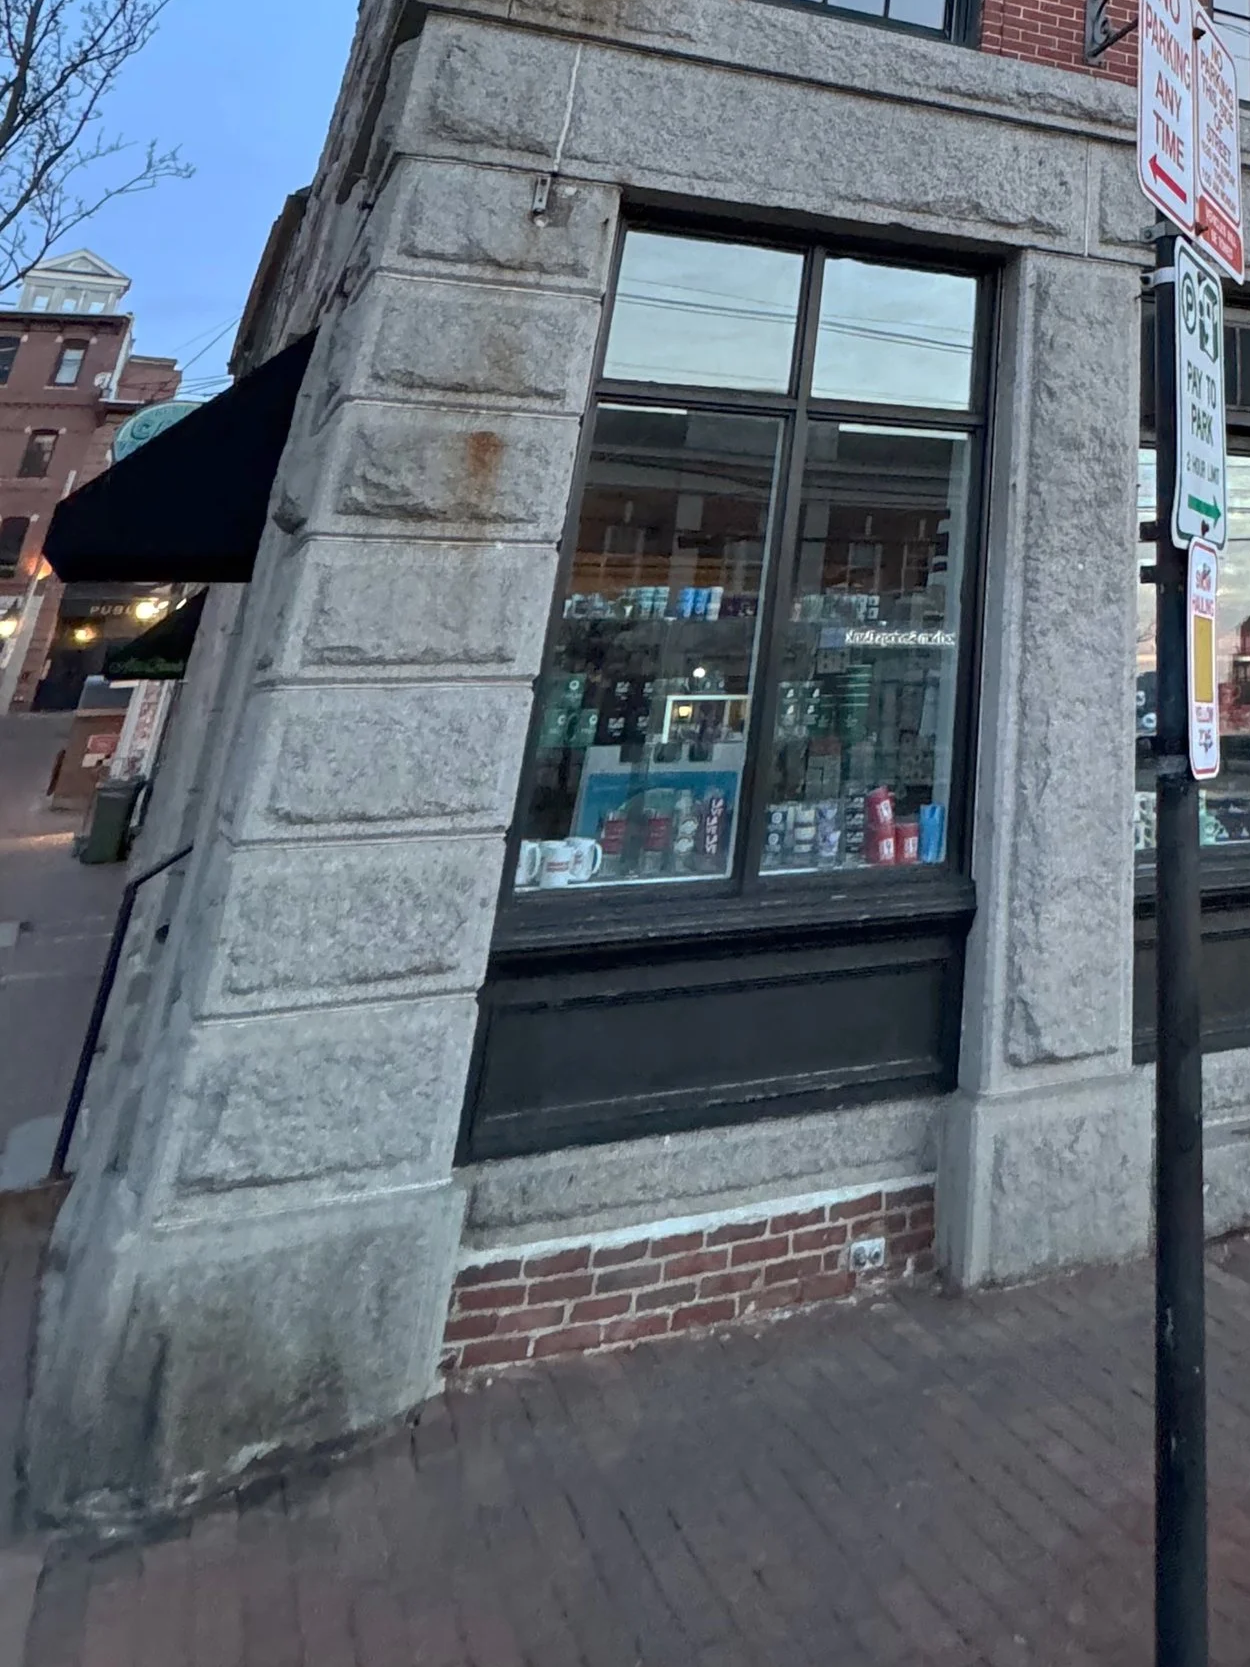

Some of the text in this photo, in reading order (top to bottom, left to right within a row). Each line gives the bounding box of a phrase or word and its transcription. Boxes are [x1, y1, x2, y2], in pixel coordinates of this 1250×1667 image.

[1200, 48, 1234, 111] PARKING
[1211, 40, 1223, 72] NO
[1155, 70, 1182, 123] ANY
[1202, 74, 1234, 132] THIS SIDE
[1153, 109, 1184, 172] TIME
[1206, 121, 1231, 167] STREET
[1213, 111, 1223, 134] OF
[1187, 359, 1217, 409] PAY TO
[1191, 401, 1214, 447] PARK
[1186, 451, 1220, 486] 2 HOUR LIMIT
